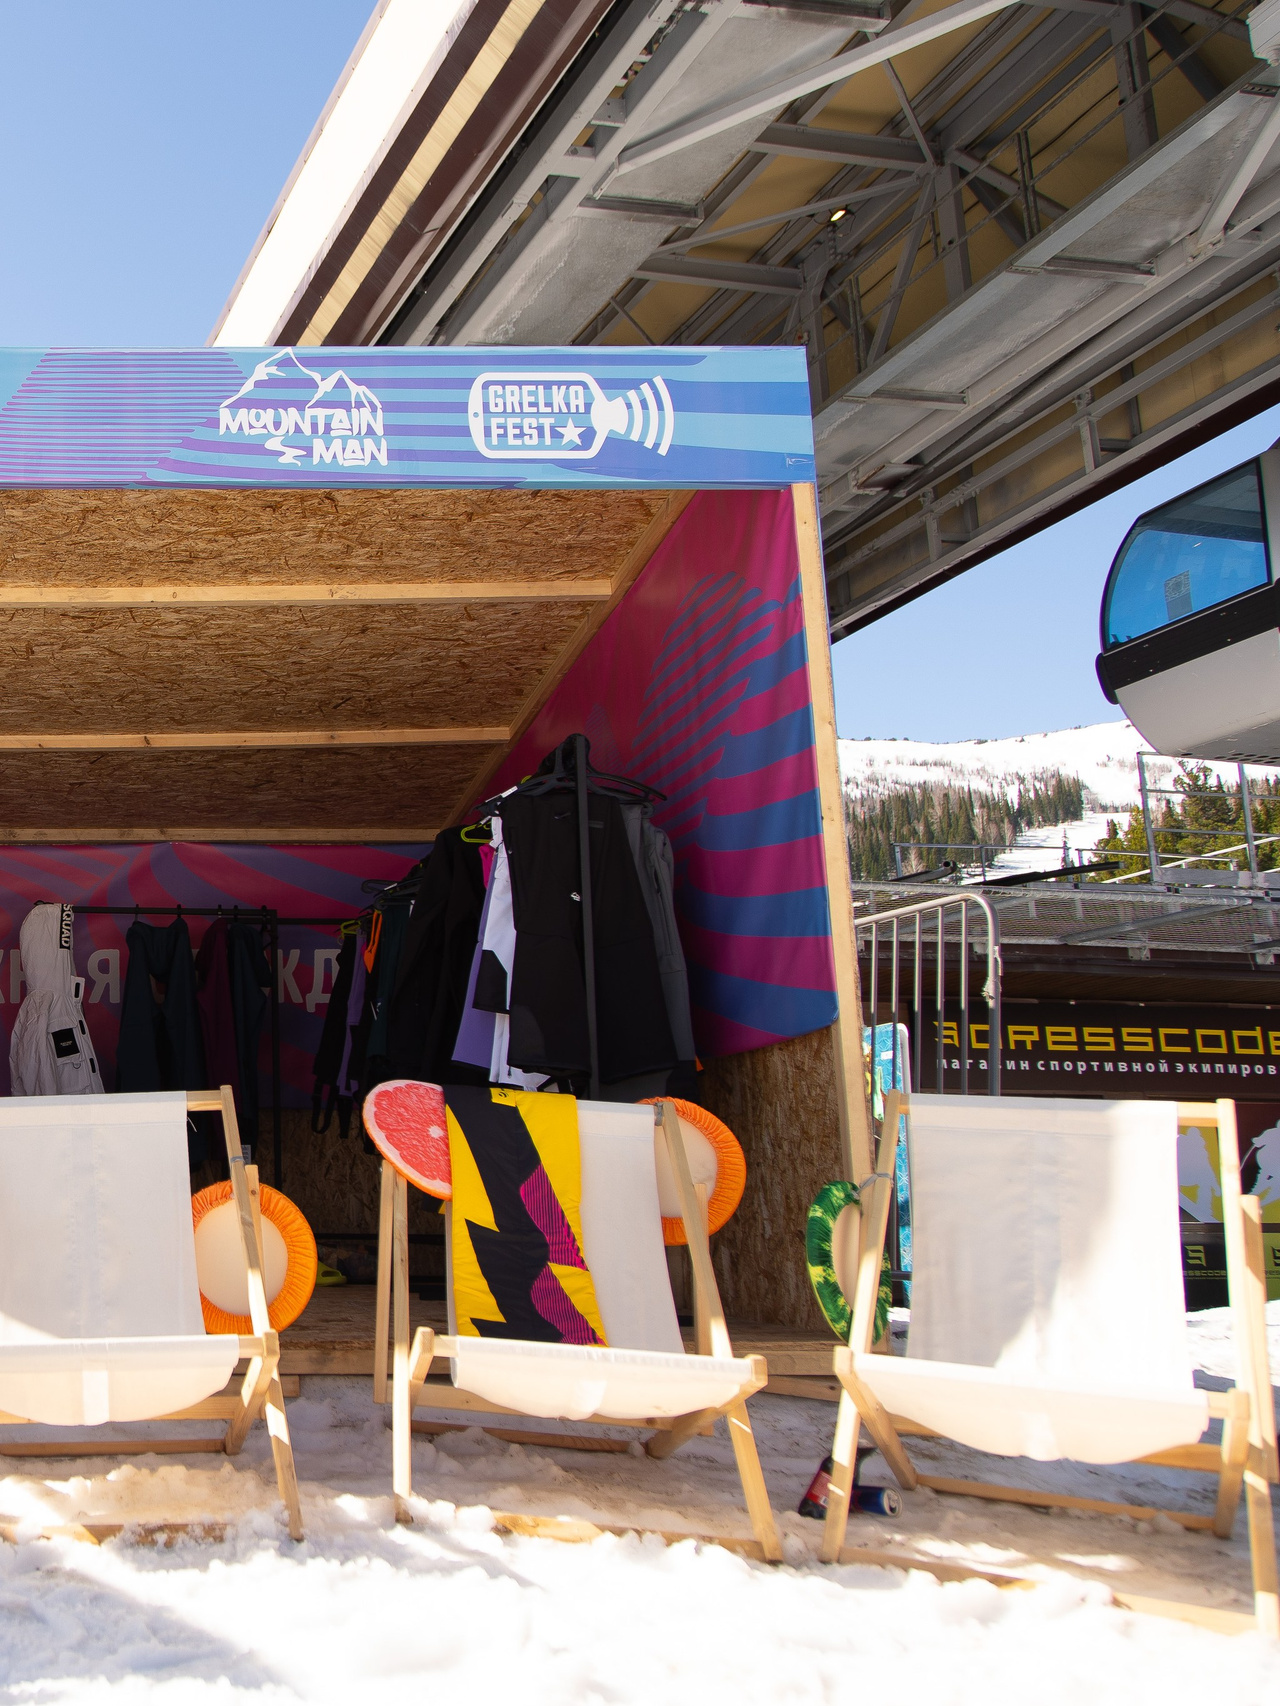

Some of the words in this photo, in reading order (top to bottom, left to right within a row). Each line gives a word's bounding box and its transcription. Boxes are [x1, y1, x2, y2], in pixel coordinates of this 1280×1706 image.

[488, 384, 586, 415] GRELKA
[220, 406, 384, 437] MOUNTAIN
[491, 416, 554, 446] FEST
[313, 437, 388, 467] MAN
[61, 903, 72, 947] SQUAD
[937, 1058, 1030, 1071] агаин
[1037, 1060, 1170, 1075] спортивной
